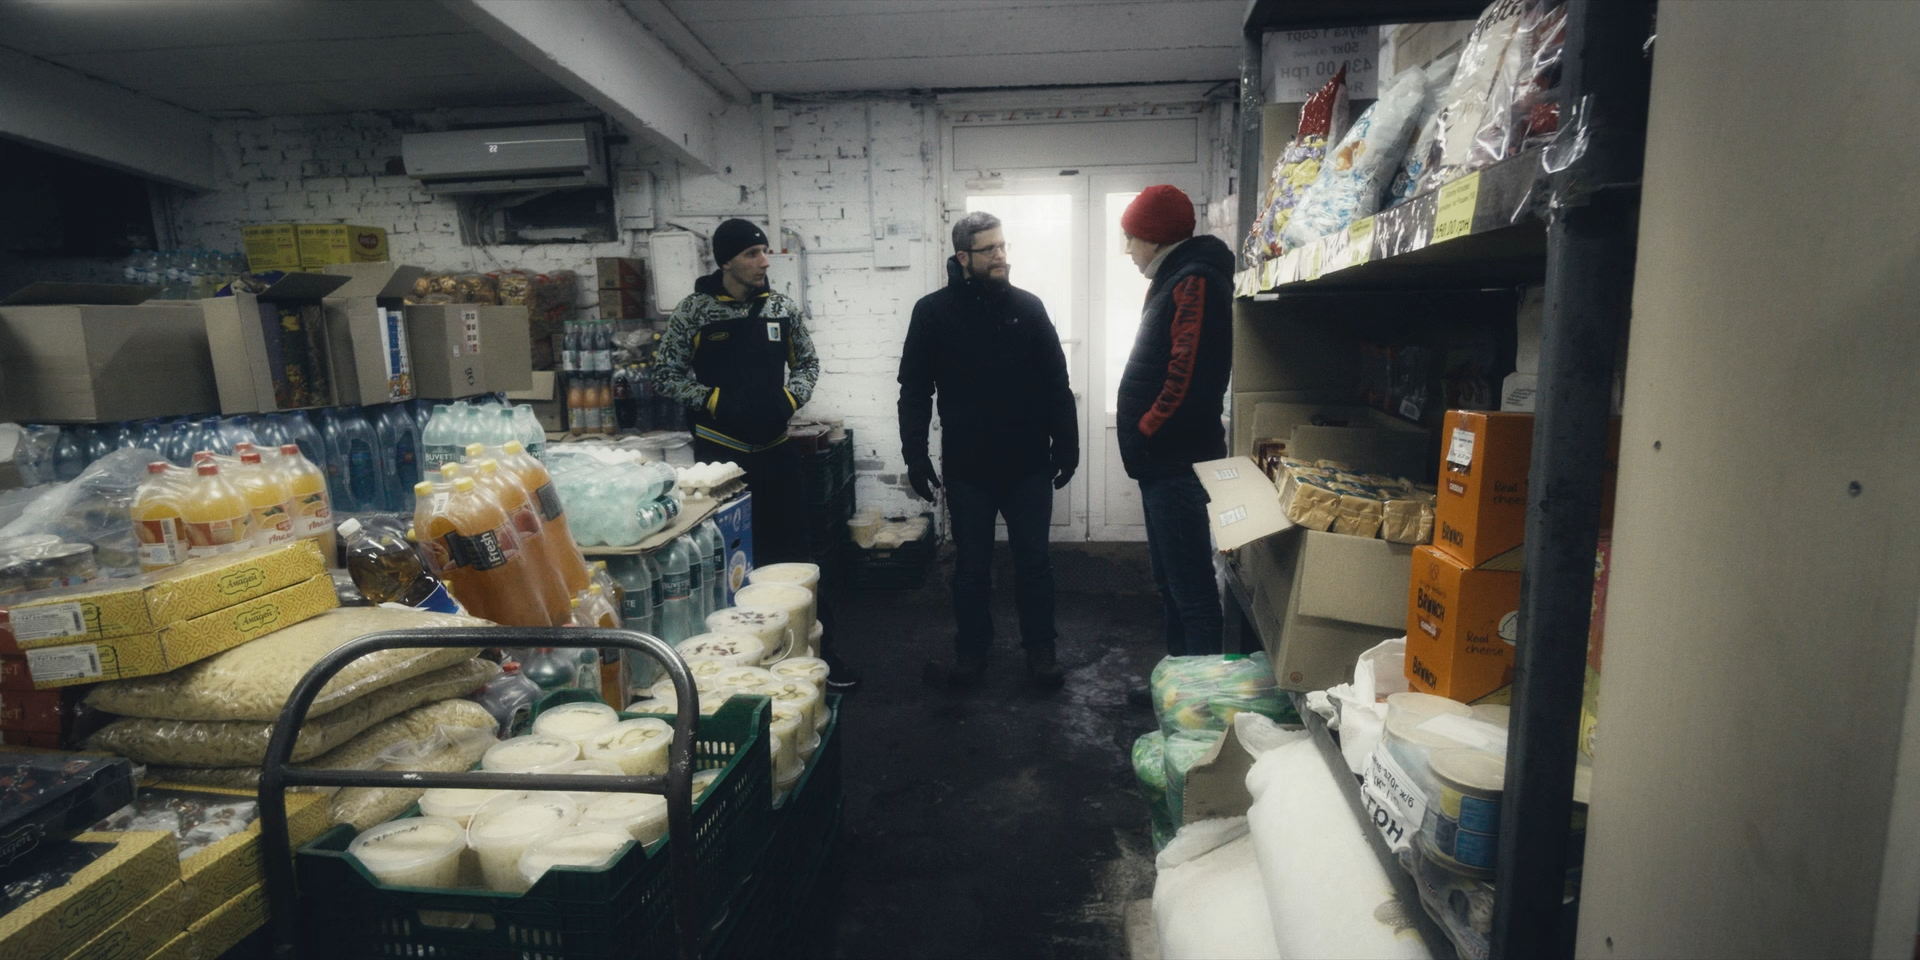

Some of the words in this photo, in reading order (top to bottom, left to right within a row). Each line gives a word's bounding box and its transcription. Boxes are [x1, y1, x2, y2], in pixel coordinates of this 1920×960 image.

[425, 452, 455, 461] BUVETT
[1466, 631, 1489, 644] Real
[1465, 645, 1504, 656] cheese
